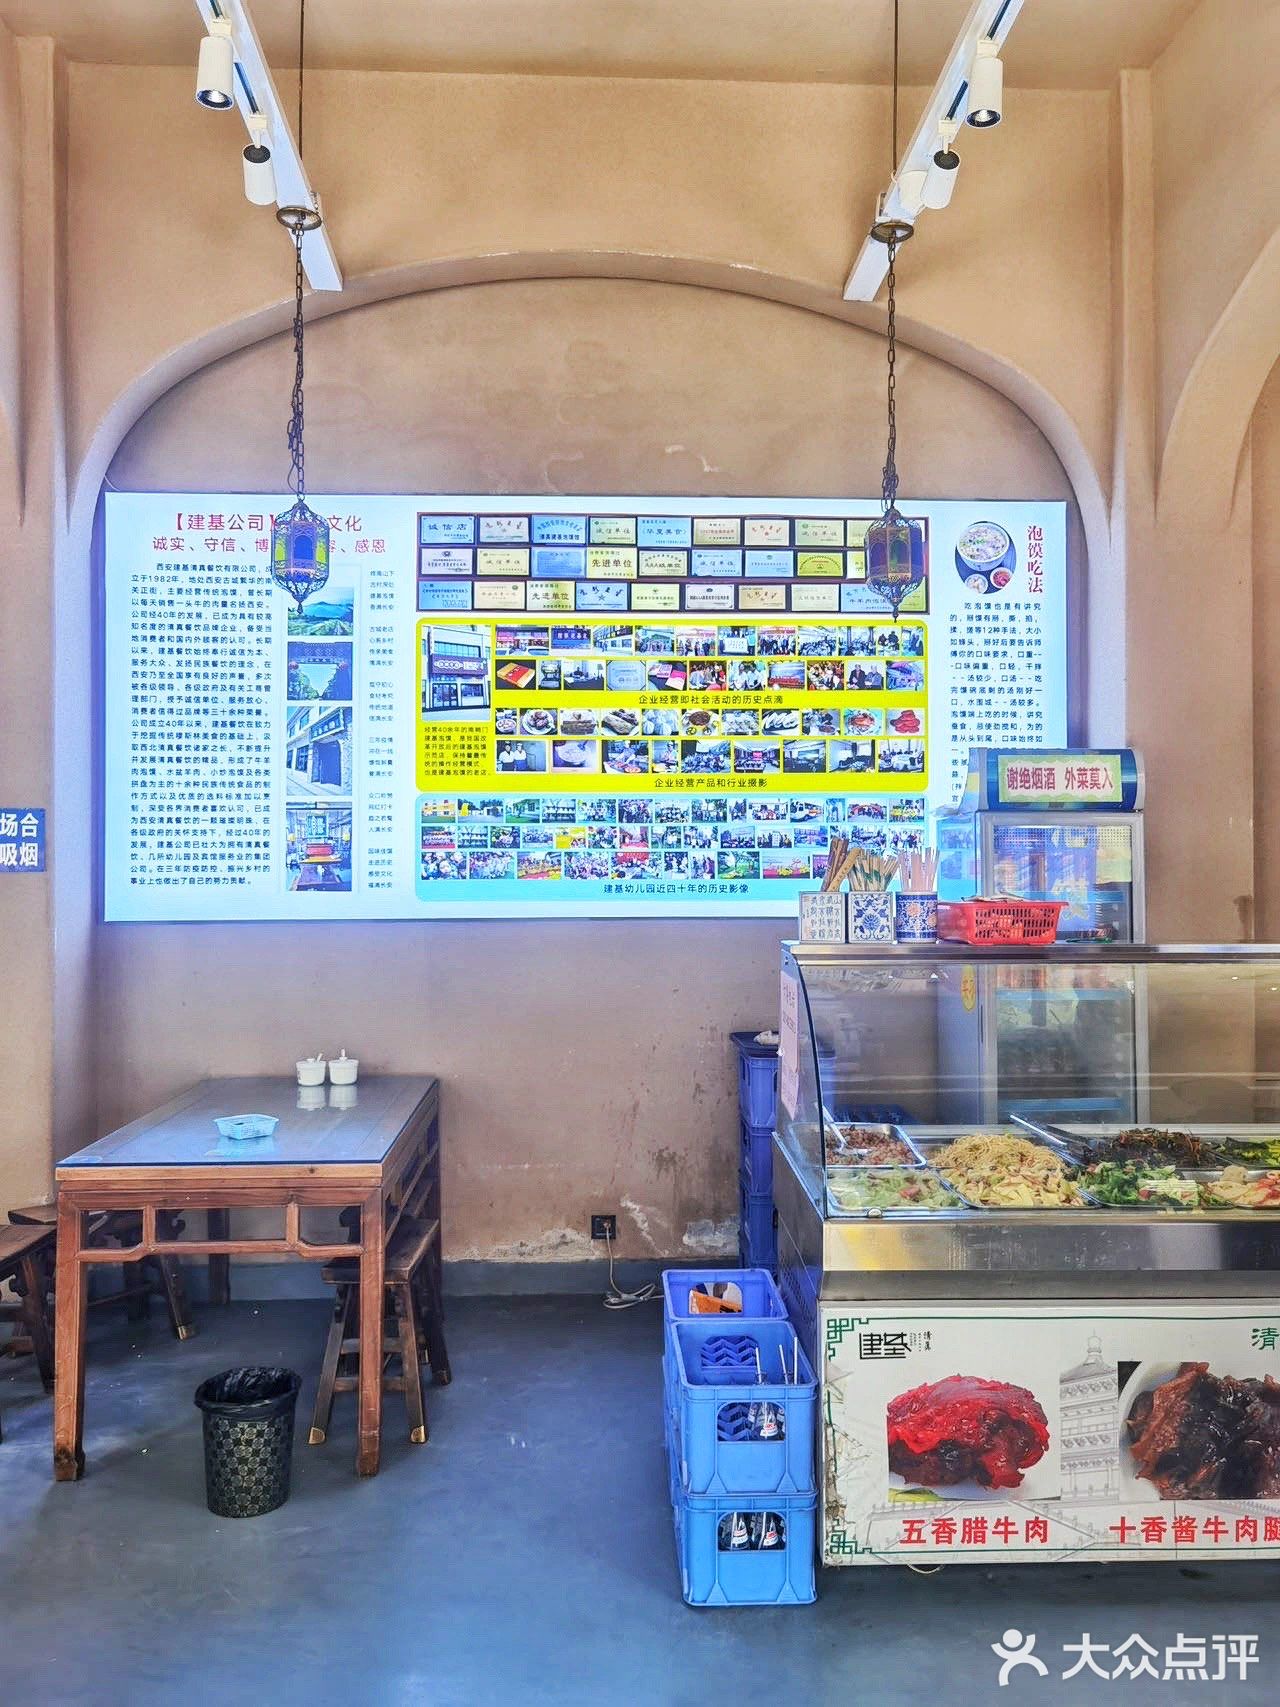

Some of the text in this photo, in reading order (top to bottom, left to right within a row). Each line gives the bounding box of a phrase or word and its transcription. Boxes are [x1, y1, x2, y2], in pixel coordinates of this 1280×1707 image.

[592, 559, 633, 568] 先进单位
[1027, 525, 1043, 593] 泡馍吃法
[531, 592, 570, 601] 先进单位
[638, 694, 784, 704] 企业经营即社会活动的历史点滴
[654, 778, 768, 788] 企业经营产品和行业摄影
[1007, 767, 1114, 791] 谢绝烟酒 外菜莫入
[0, 812, 39, 838] 场合
[0, 842, 39, 867] 吸烟
[603, 884, 749, 894] 建基幼儿园近四十年的历史影像
[902, 1516, 1049, 1544] 五香腊牛肉
